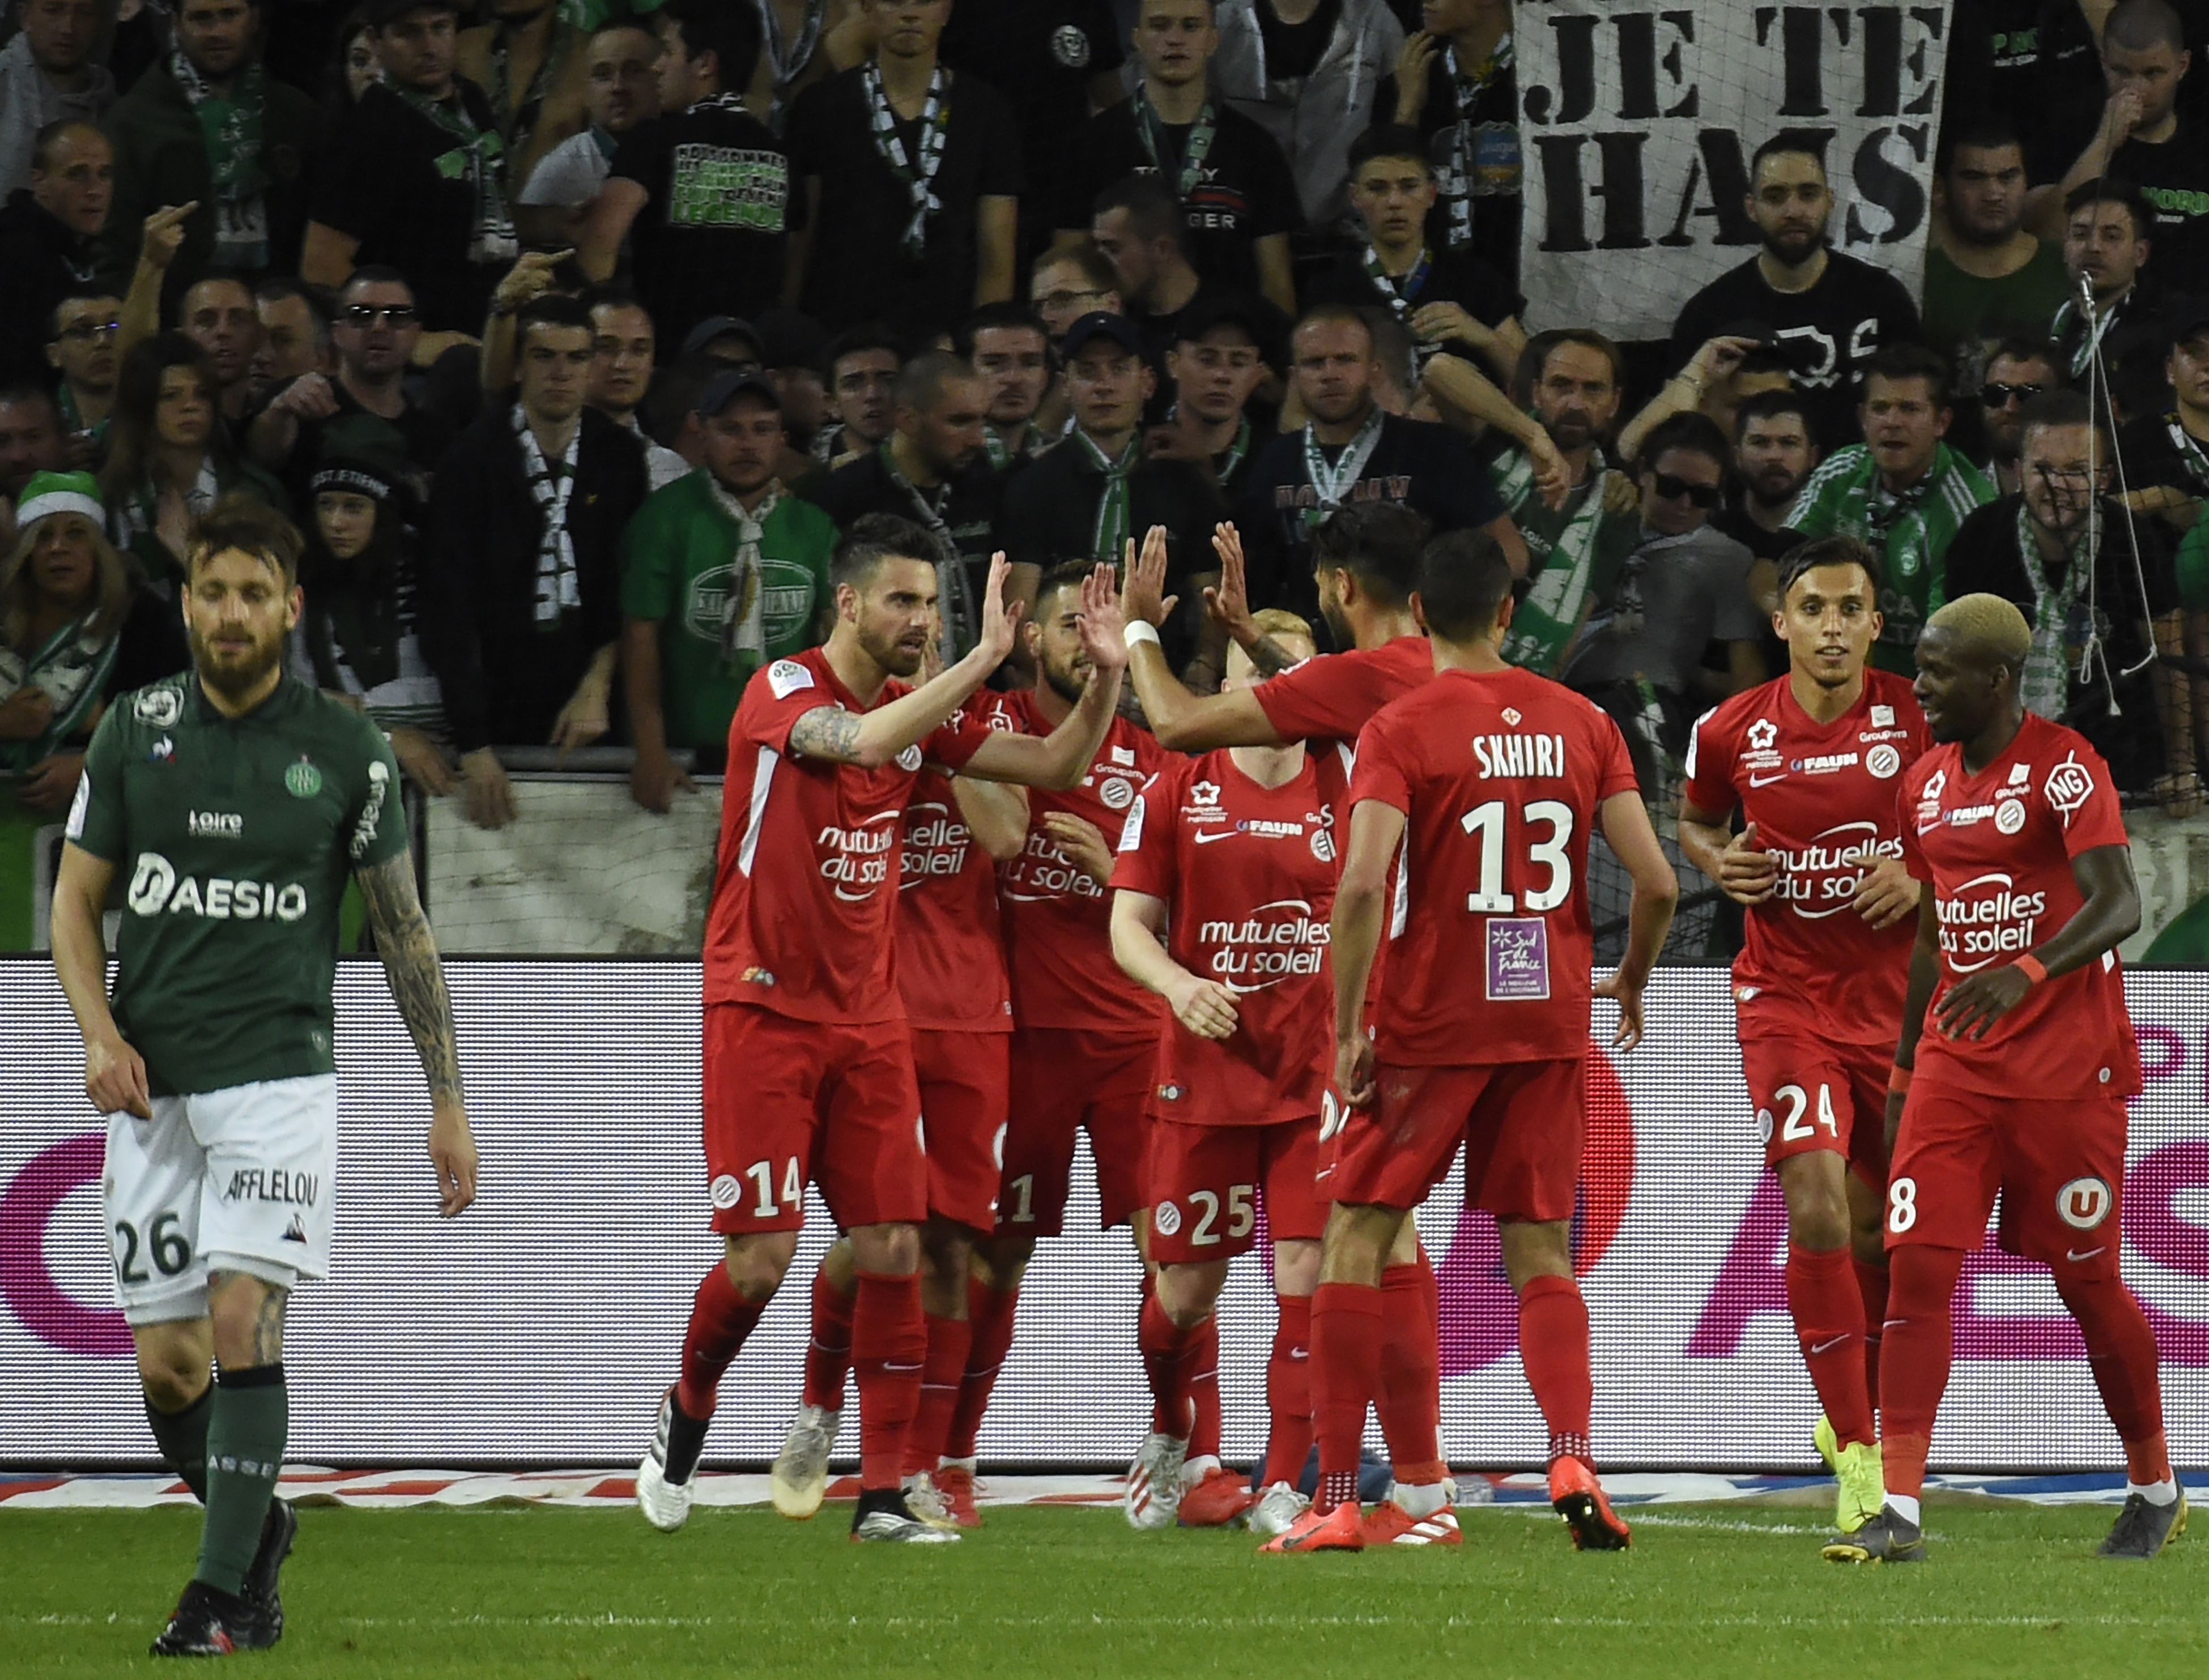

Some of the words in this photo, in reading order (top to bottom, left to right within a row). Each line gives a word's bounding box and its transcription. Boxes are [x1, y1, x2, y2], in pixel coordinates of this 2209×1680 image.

[1523, 10, 1699, 125] JE
[1755, 7, 1943, 117] TE
[1531, 122, 1930, 252] HAS
[1472, 734, 1564, 779] SKHIRI
[1803, 752, 1858, 770] FAUN
[2050, 769, 2084, 804] NG
[1249, 820, 1303, 836] FAUN
[821, 856, 855, 880] du
[1460, 800, 1573, 913] 13
[1820, 869, 1864, 898] sol
[1201, 918, 1331, 945] mutuelles
[1964, 919, 2034, 953] soleil
[1212, 945, 1247, 973] du
[1252, 945, 1323, 974] soleil
[1497, 950, 1541, 976] France
[1775, 1083, 1838, 1141] 24
[224, 1169, 318, 1208] AFFLELOU
[746, 1156, 803, 1218] 14
[1889, 1178, 1916, 1233] 8
[2070, 1192, 2098, 1218] U
[1188, 1184, 1255, 1246] 25
[115, 1211, 190, 1284] 26
